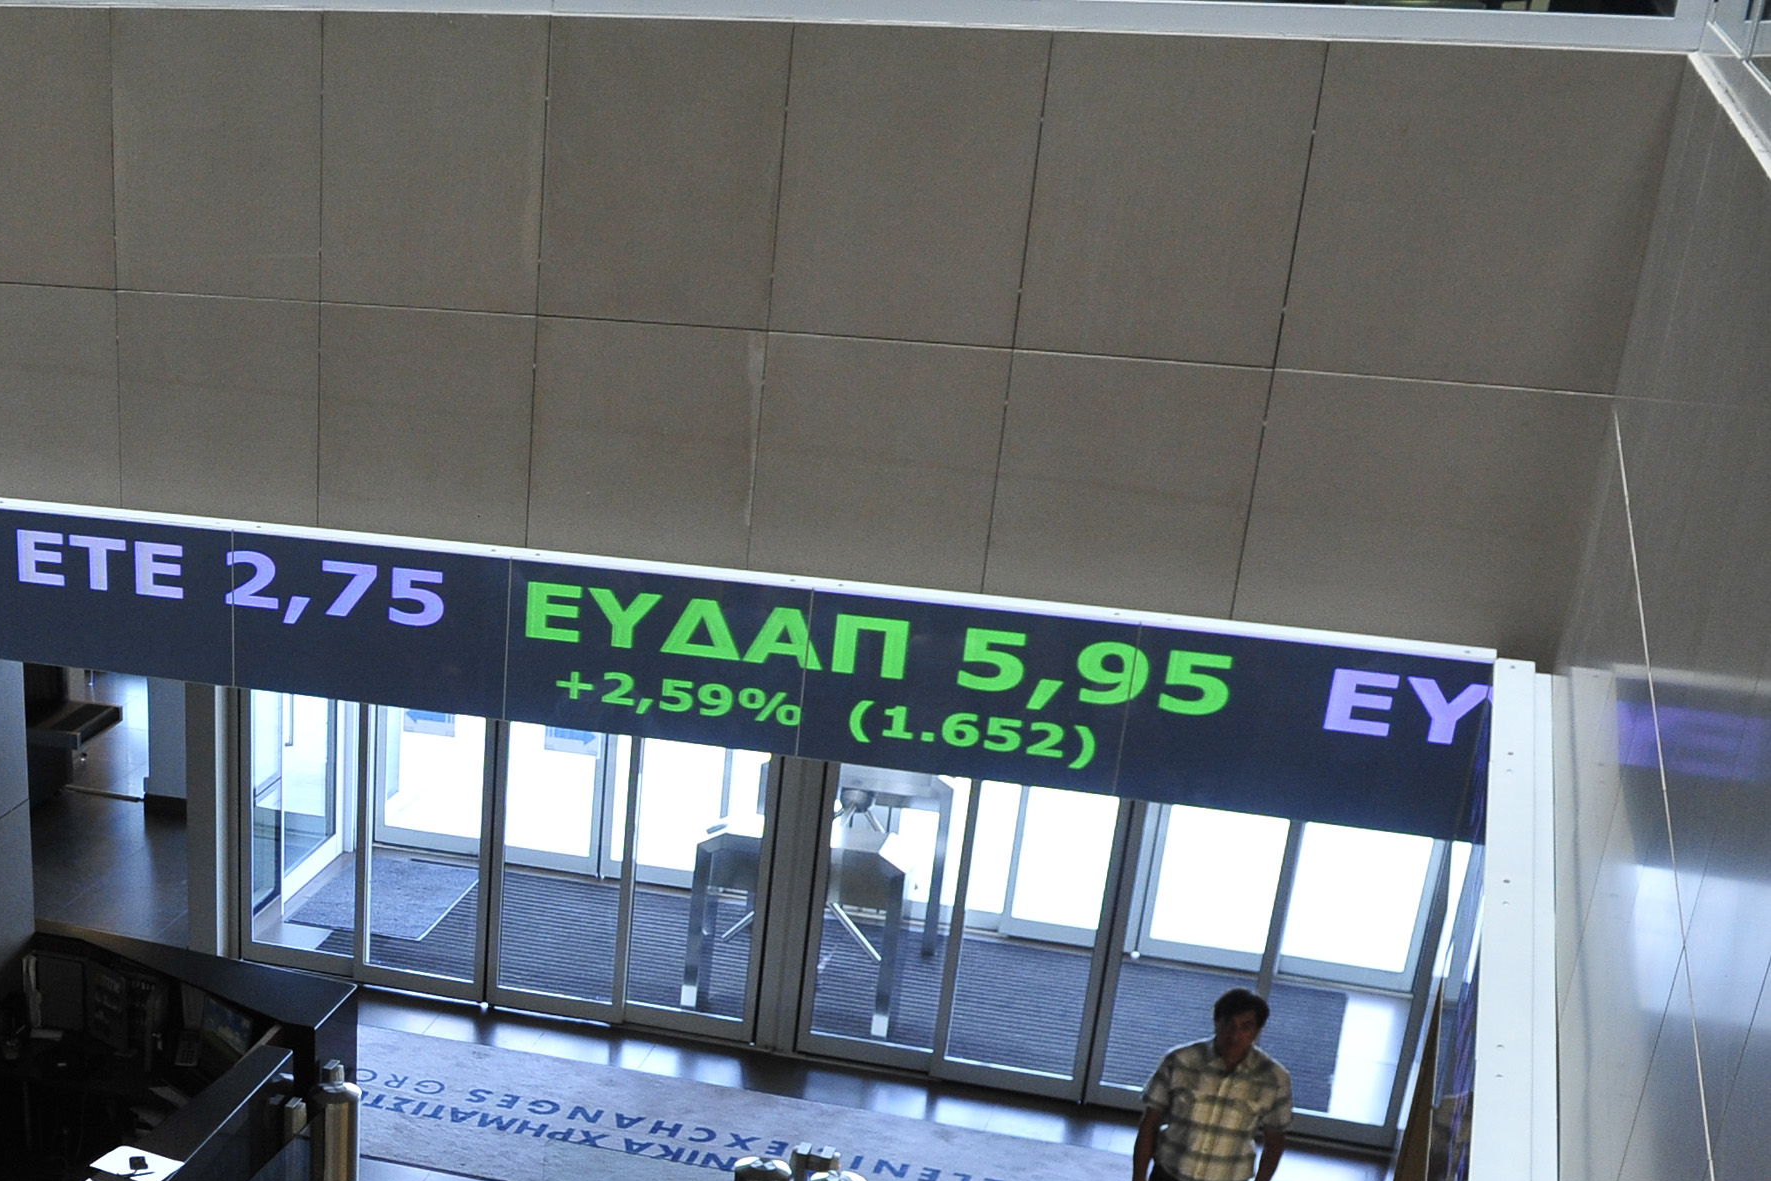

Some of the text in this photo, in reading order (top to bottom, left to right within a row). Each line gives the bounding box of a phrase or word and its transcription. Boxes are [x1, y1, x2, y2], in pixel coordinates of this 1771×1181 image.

[224, 550, 446, 627] 2,75
[525, 581, 911, 681] ΕΥΔΑΠ
[956, 627, 1233, 716] 5,95
[555, 671, 1096, 770] +2,59% (1.652)
[356, 1068, 446, 1095] GRO
[360, 1090, 611, 1148] ΧΡΗΜΑΤΙΣΤ
[465, 1089, 790, 1157] EXCHANGES
[623, 1137, 739, 1172] ΝΙΚΑ
